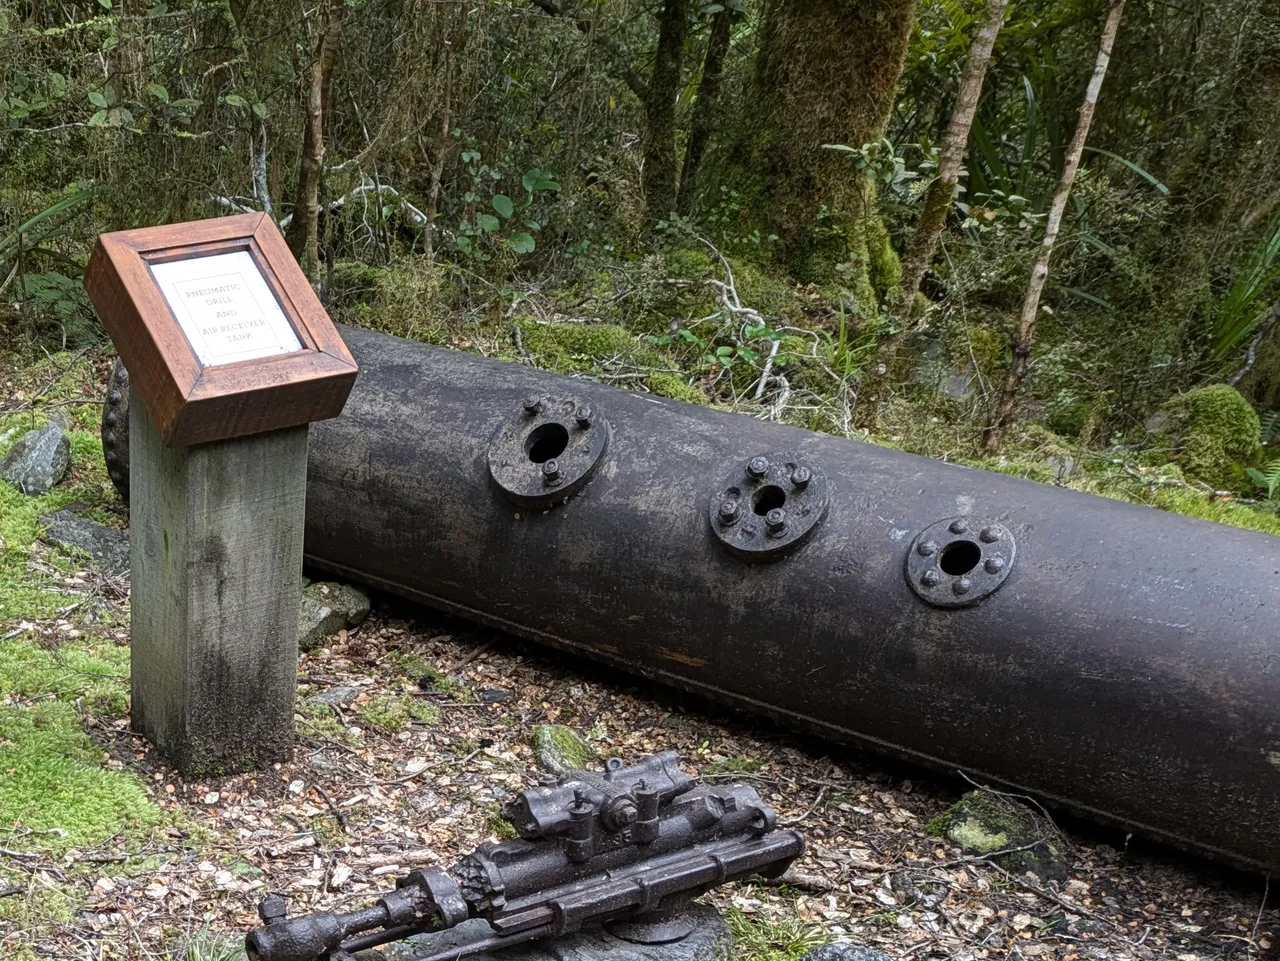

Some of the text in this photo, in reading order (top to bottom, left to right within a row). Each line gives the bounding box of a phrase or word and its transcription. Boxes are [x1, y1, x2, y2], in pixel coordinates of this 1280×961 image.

[185, 283, 241, 298] PNEUMATIC
[205, 296, 233, 306] DRILL
[216, 310, 237, 318] AND
[203, 319, 266, 336] AIR RECEIVER
[226, 332, 253, 342] TANK
